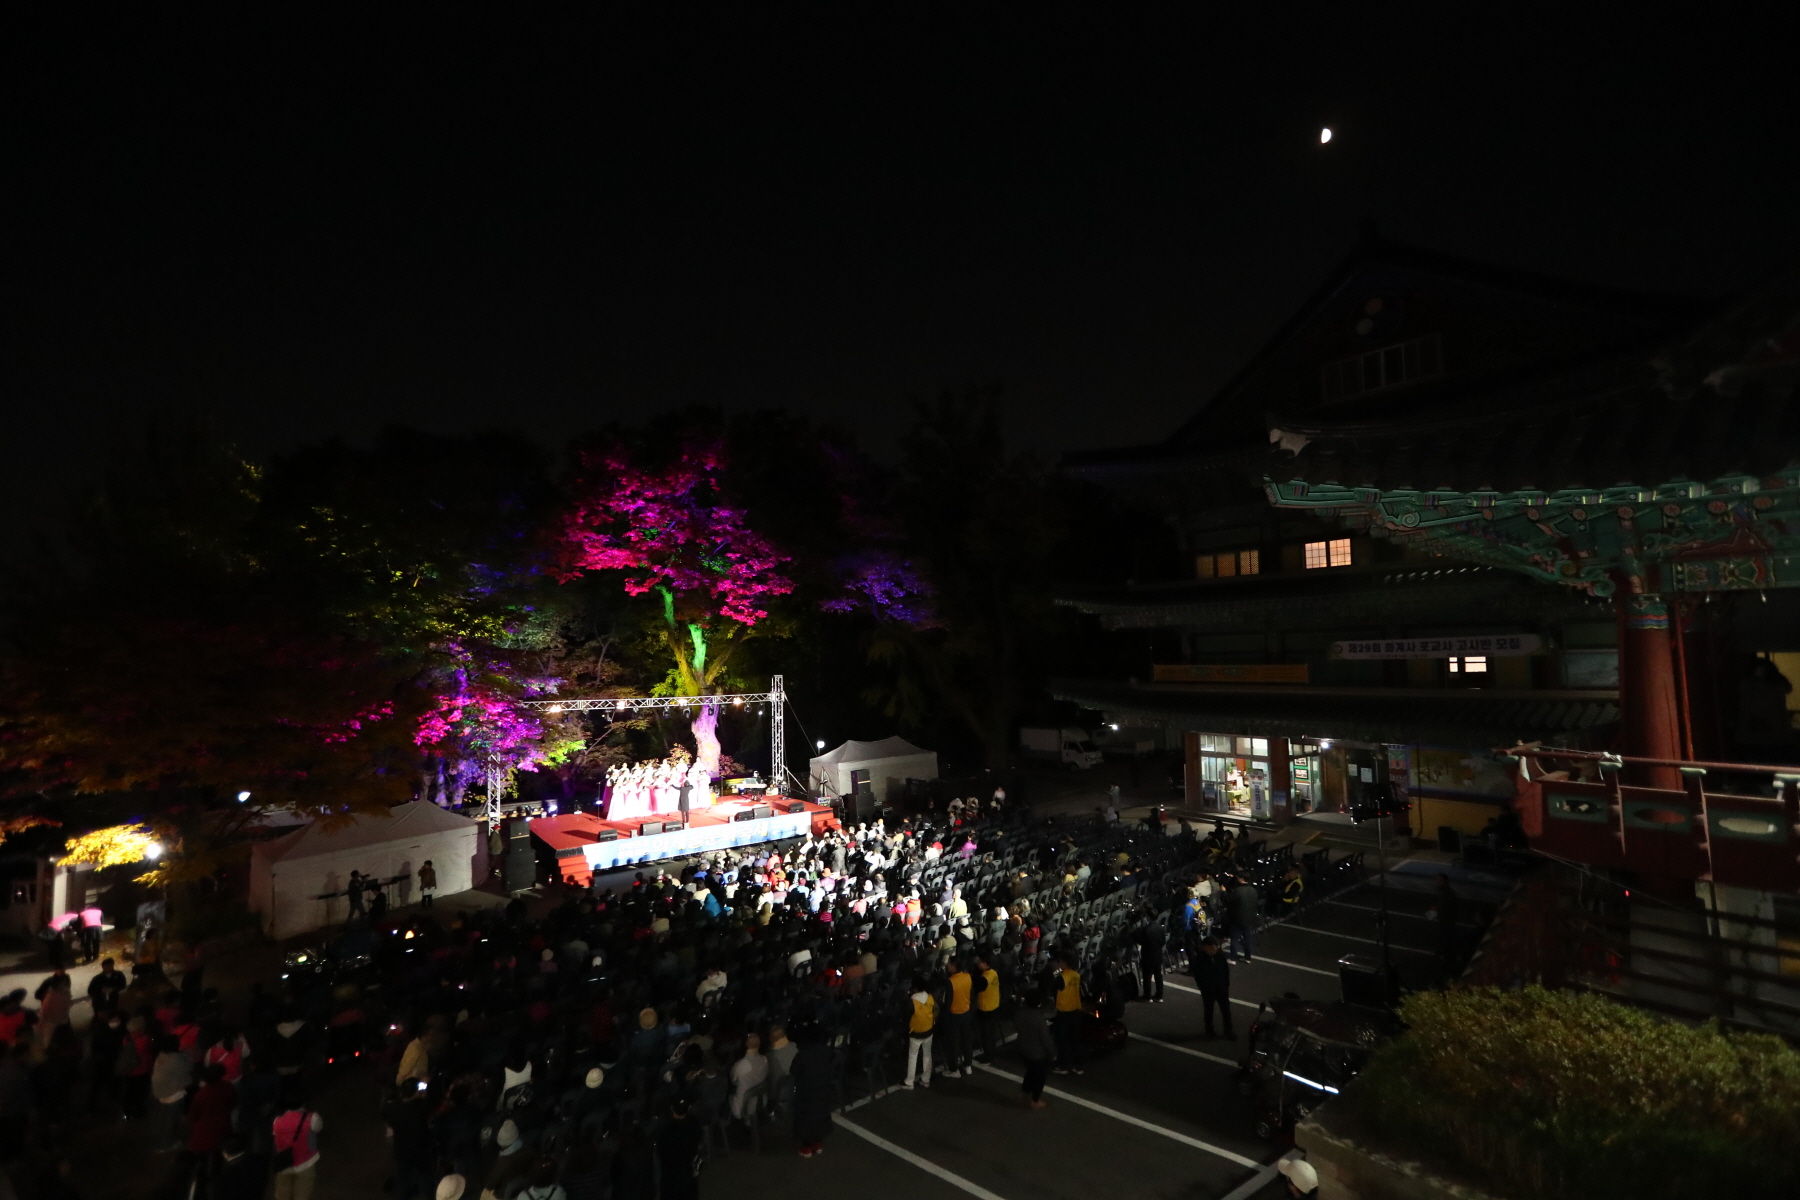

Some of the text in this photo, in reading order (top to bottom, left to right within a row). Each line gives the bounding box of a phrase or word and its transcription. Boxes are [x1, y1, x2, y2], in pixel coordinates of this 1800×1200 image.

[1348, 638, 1521, 653] 제29회 화계사 포교사 고시반 모집
